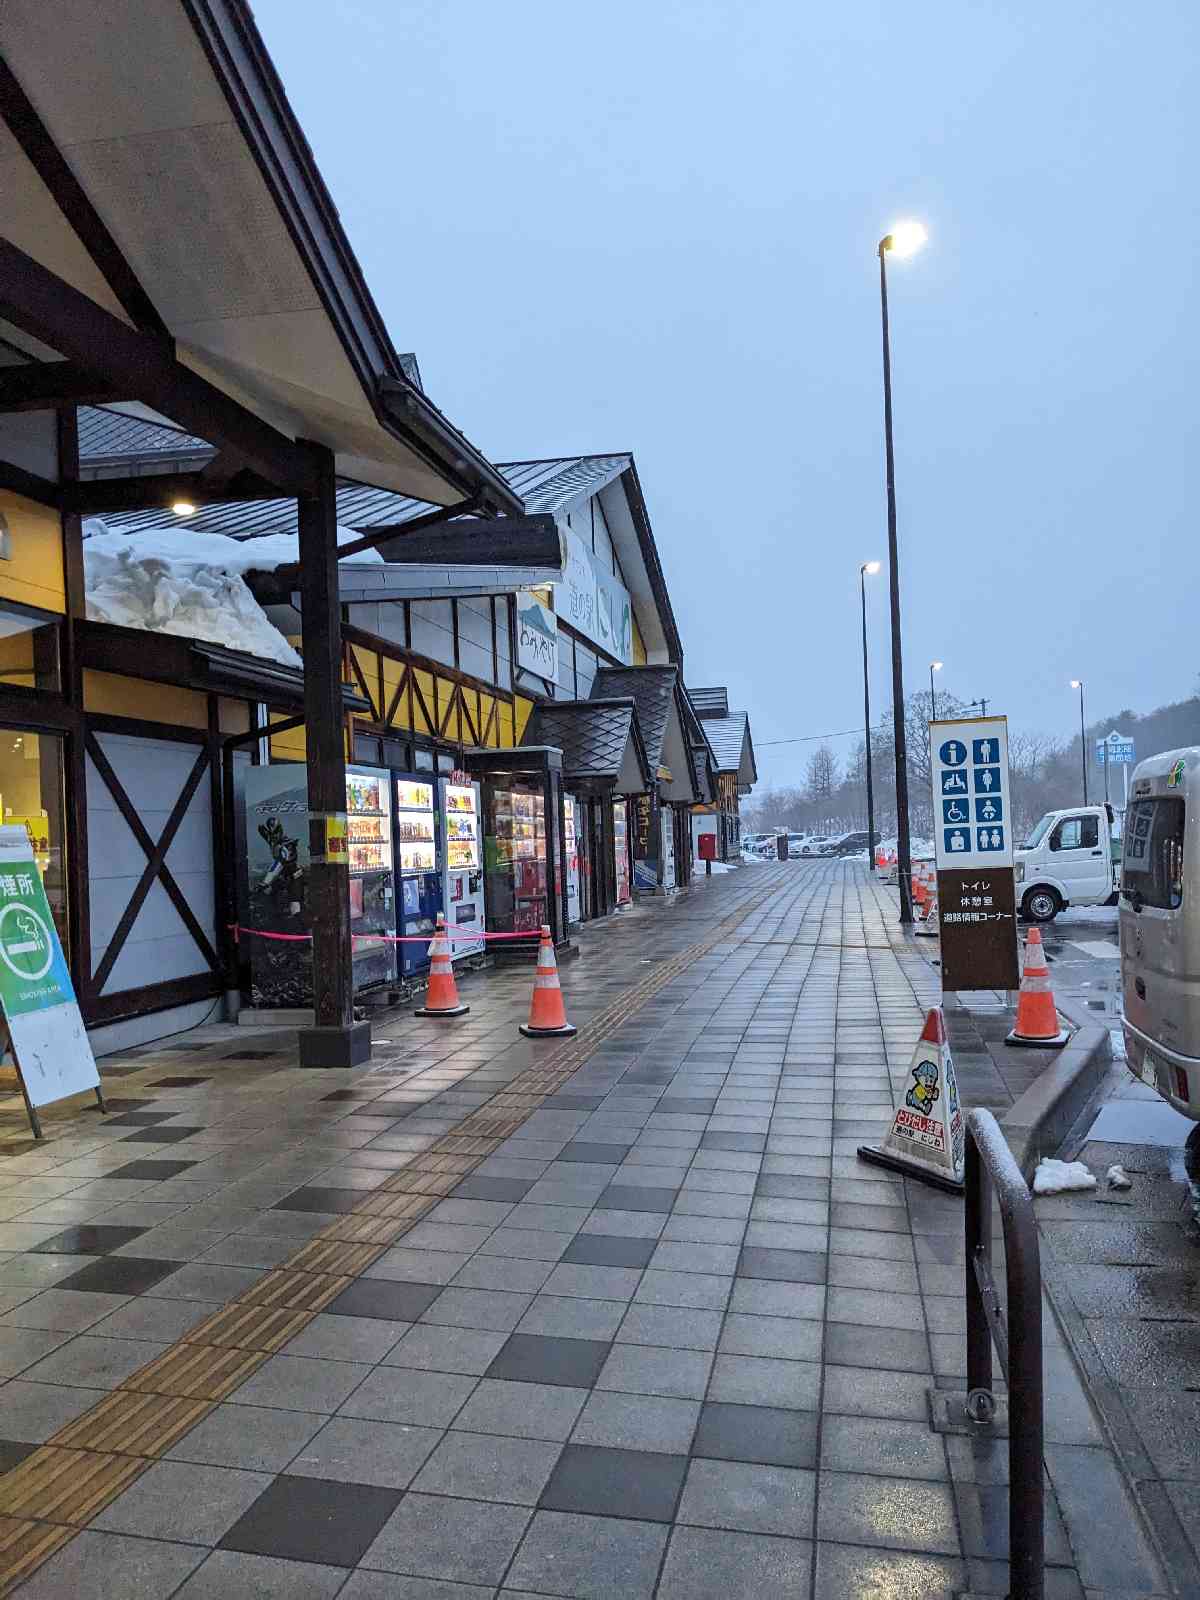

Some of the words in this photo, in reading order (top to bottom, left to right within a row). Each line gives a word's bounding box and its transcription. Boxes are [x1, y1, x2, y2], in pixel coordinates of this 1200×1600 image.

[961, 881, 991, 893] トイレ
[960, 896, 993, 908] 休憩室
[943, 912, 1013, 924] 道路情報コーナー
